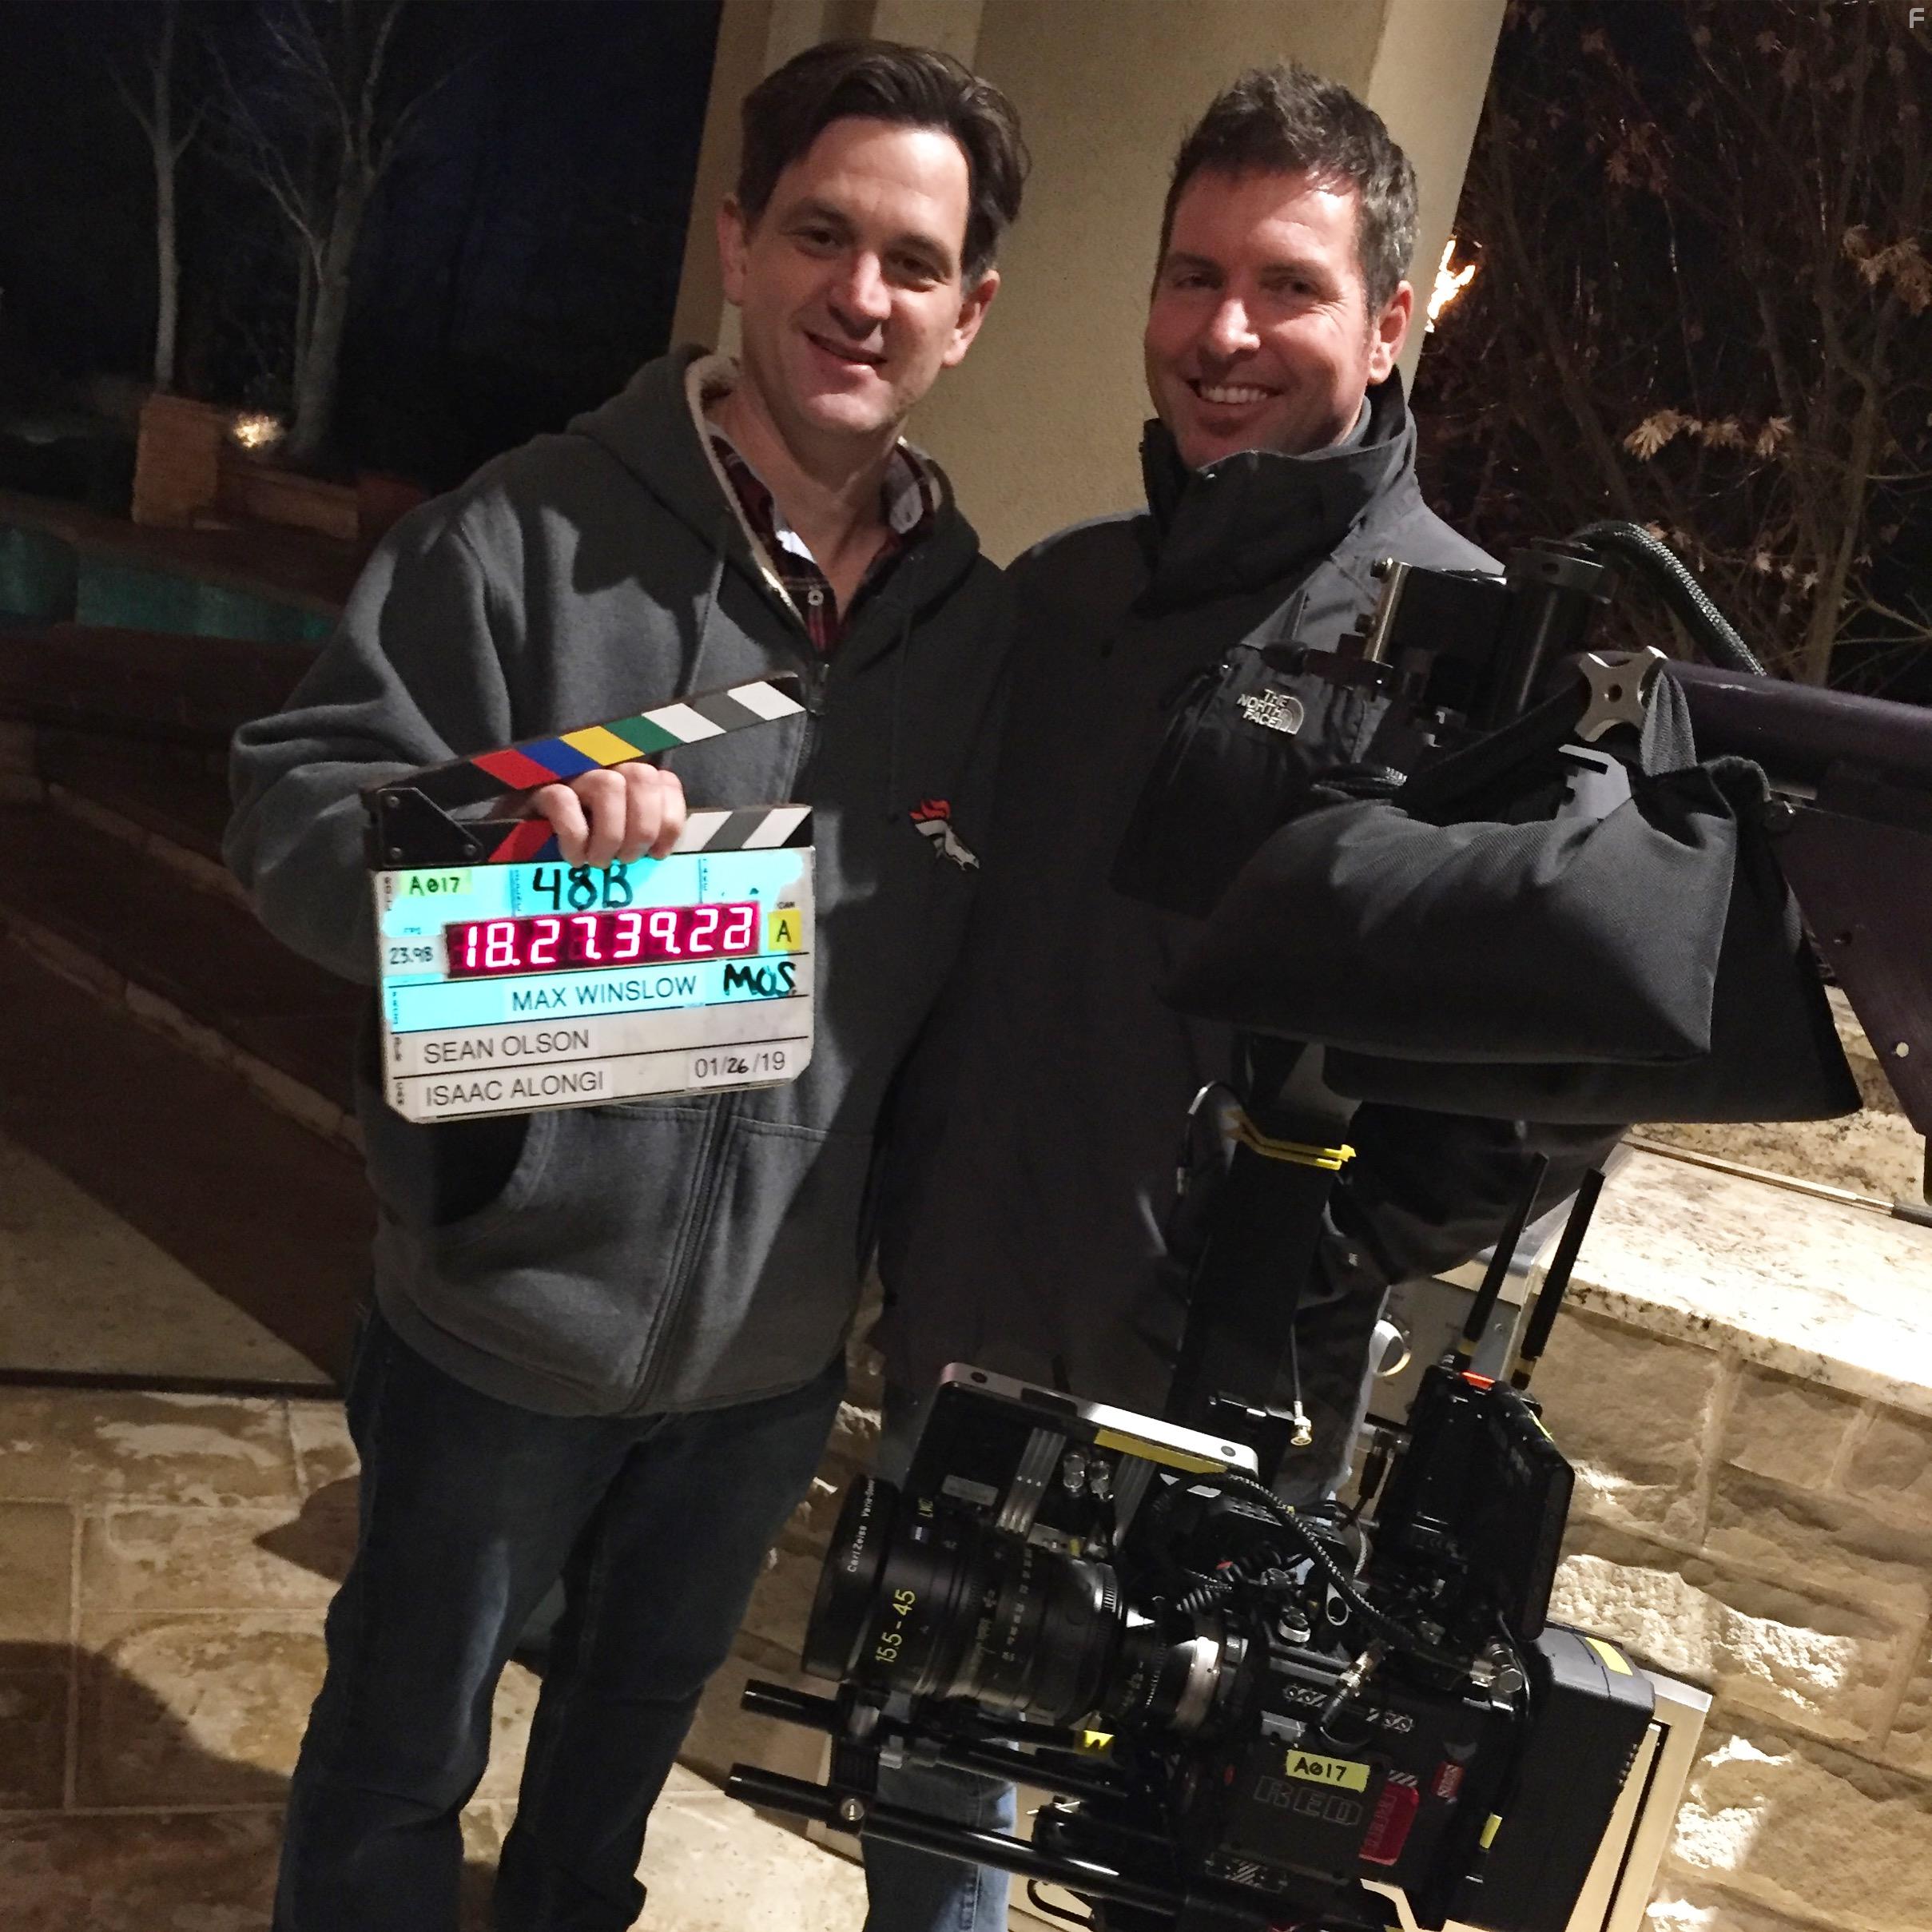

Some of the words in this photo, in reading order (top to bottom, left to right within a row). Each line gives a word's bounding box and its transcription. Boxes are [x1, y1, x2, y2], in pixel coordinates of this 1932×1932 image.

[1236, 694, 1282, 717] NORTH
[1264, 689, 1288, 707] THE
[1242, 708, 1282, 729] FACE
[532, 860, 634, 912] 48B
[775, 919, 793, 943] A
[723, 960, 797, 997] MOS
[511, 987, 567, 1012] MAX
[576, 976, 697, 1005] WINSLOW
[423, 1039, 495, 1064] SEAN
[501, 1029, 590, 1057] OLSON
[426, 1080, 503, 1107] ISAAC
[509, 1071, 603, 1098] ALONGI
[852, 1525, 867, 1550] Zeiss
[846, 1551, 861, 1572] Carl
[1254, 1775, 1364, 1827] RED
